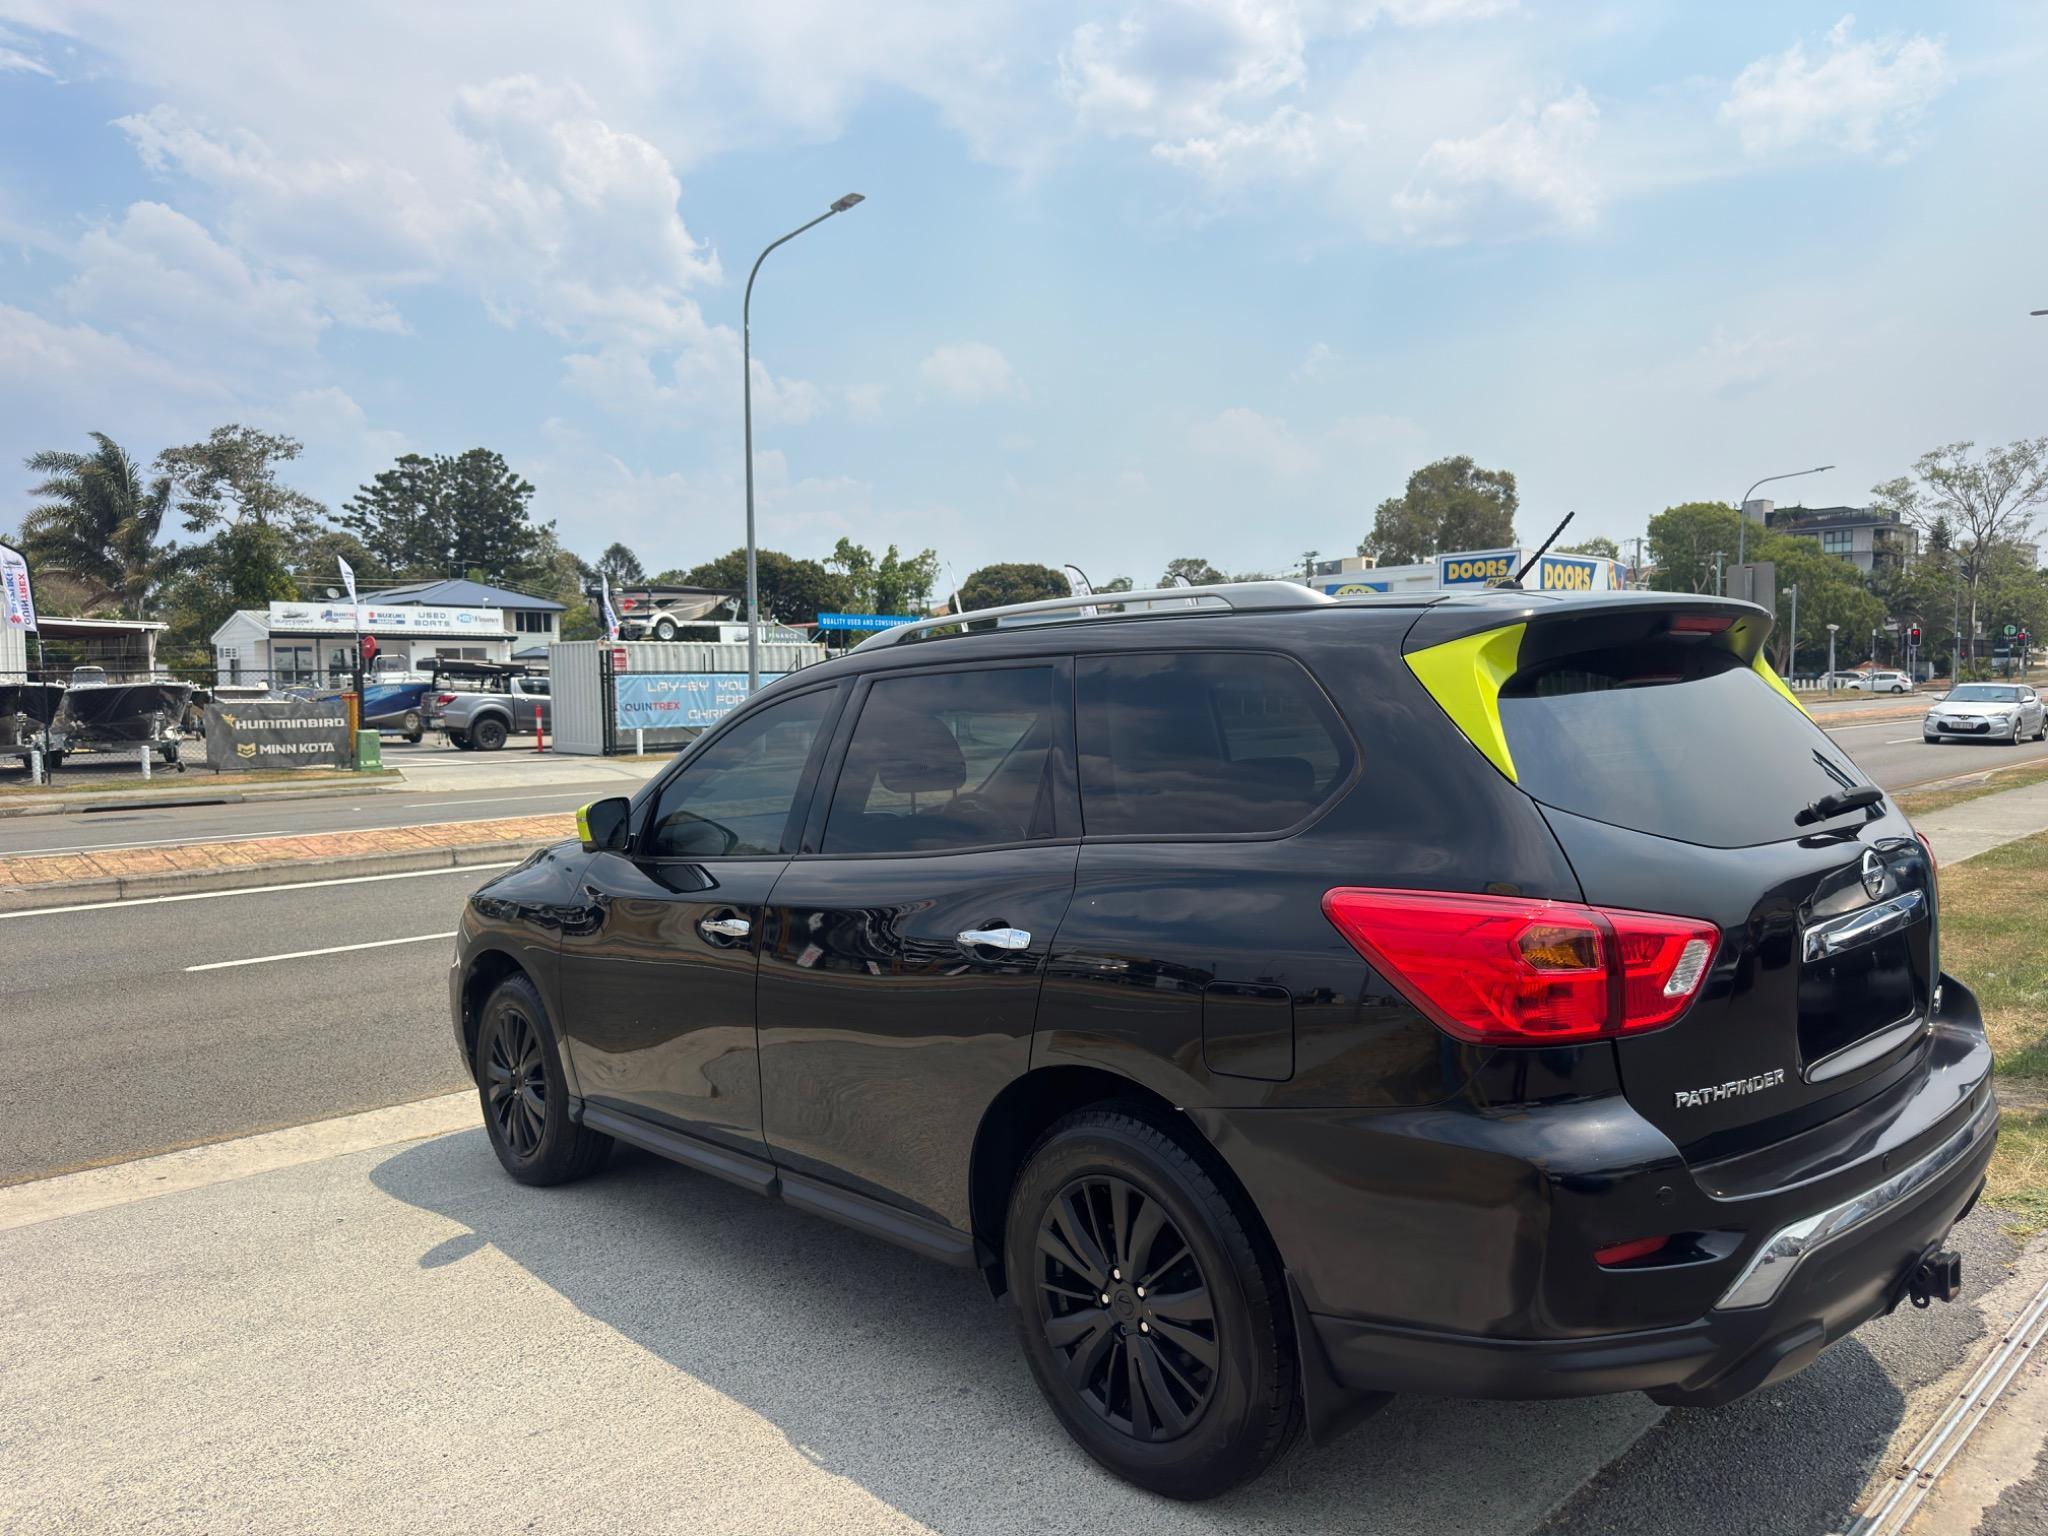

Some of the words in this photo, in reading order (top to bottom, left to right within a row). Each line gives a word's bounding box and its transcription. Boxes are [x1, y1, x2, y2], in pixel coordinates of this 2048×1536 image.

[1448, 559, 1508, 580] DOORS
[1544, 563, 1592, 592] DOORS
[769, 632, 798, 640] FNANCE
[648, 680, 709, 693] LAY-BY
[625, 701, 680, 711] QUINTREX
[236, 718, 345, 730] HUMMINBIRD
[260, 744, 297, 755] MINN
[299, 742, 335, 753] KOTA
[1675, 1069, 1784, 1108] PATHFINDER
